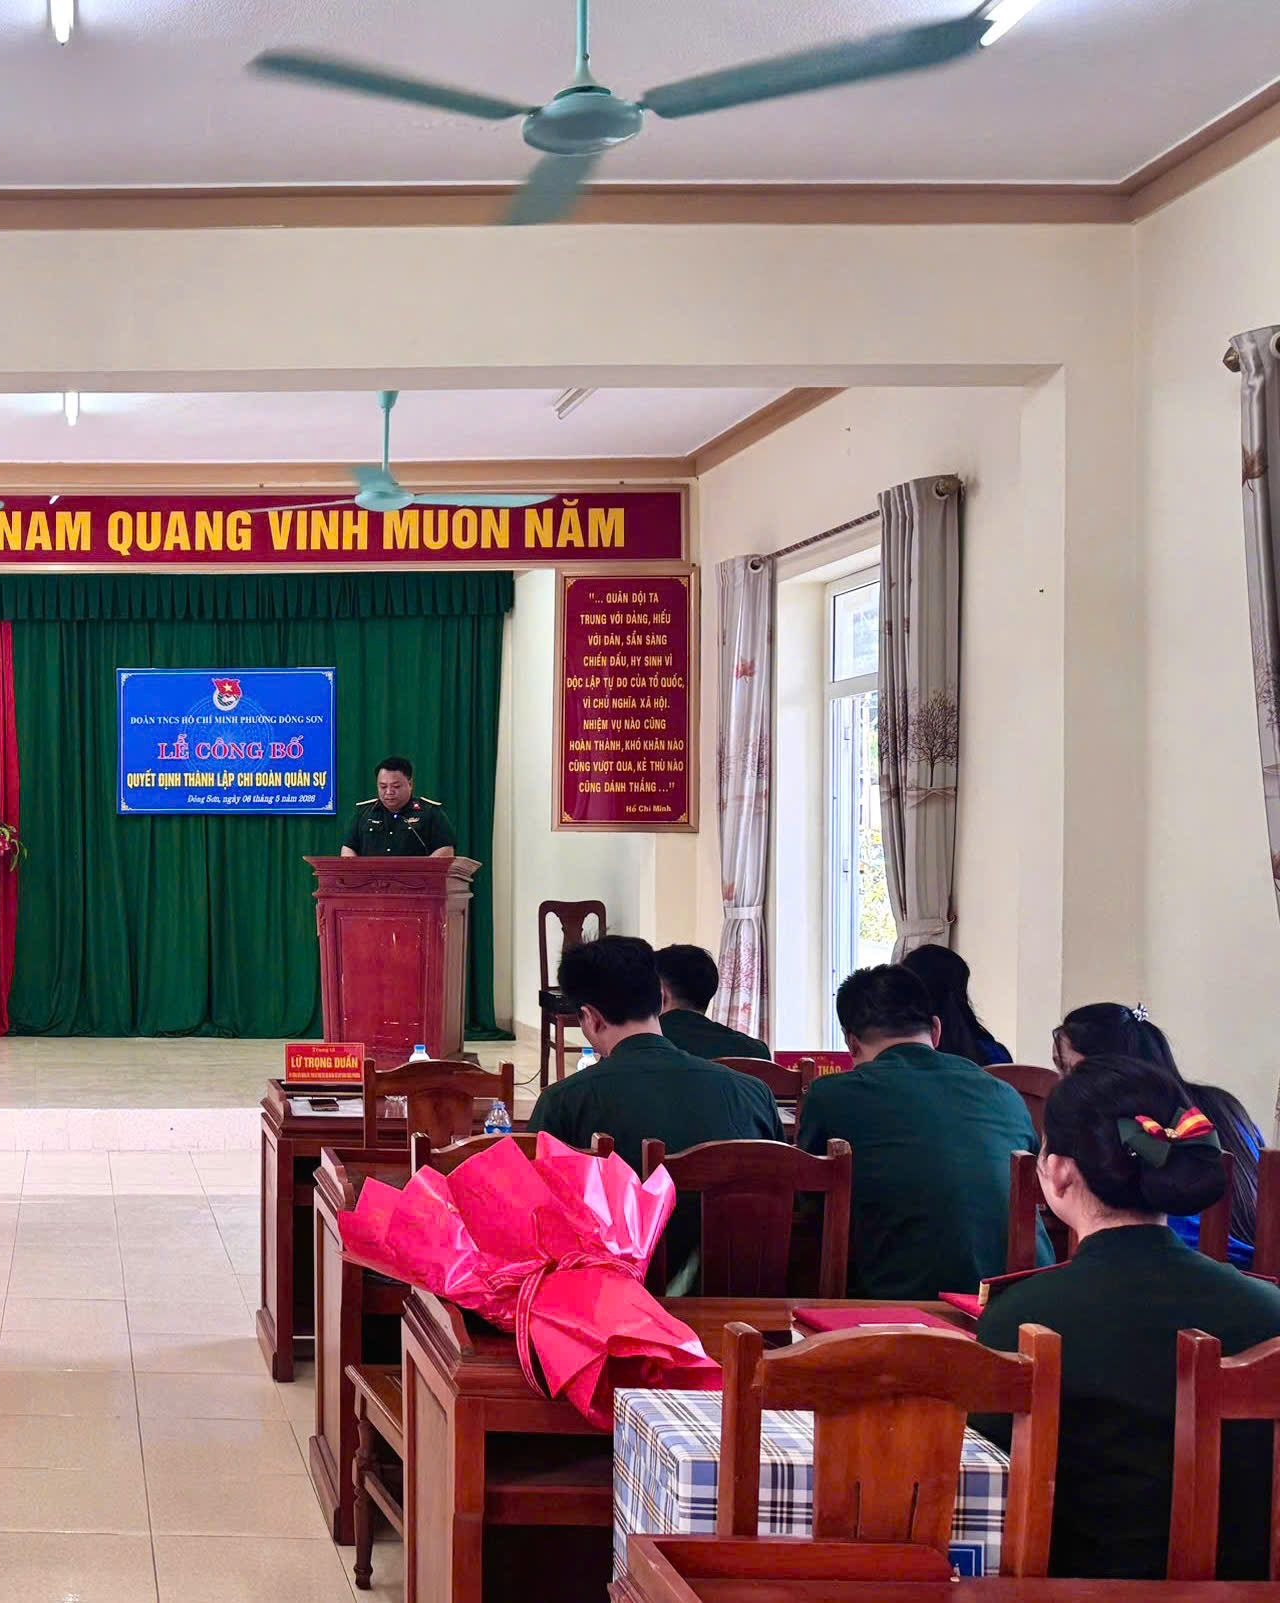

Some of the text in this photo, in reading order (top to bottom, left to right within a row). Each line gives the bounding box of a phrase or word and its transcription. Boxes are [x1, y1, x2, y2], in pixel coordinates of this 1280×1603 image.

[107, 510, 252, 557] QUANG
[267, 510, 368, 550] VINH
[524, 498, 625, 549] NĂM
[606, 591, 628, 603] QUÂN
[632, 591, 646, 606] ĐỘI
[649, 593, 658, 603] TA
[580, 614, 606, 624] TRUNG
[610, 611, 623, 624] VỚI
[653, 609, 671, 624] HIẾU
[588, 633, 601, 645] VỚI
[604, 633, 624, 646] DÂN,
[646, 632, 667, 645] SÀNG
[584, 651, 606, 666] CHIẾN
[631, 656, 641, 666] HY
[644, 656, 662, 666] SINH
[665, 653, 672, 666] VÌ
[567, 675, 583, 690] ĐỘC
[586, 675, 600, 690] LẬP
[604, 677, 614, 690] TỰ
[617, 678, 627, 687] DO
[631, 673, 646, 687] CỦA
[649, 672, 658, 687] TỔ
[583, 696, 590, 708] VÌ
[593, 695, 609, 708] CHỦ
[612, 696, 636, 708] NGHĨA
[640, 696, 651, 708] XÃ
[130, 715, 155, 724] ĐOÀN
[182, 715, 194, 724] HỒ
[196, 715, 212, 724] CHÍ
[214, 716, 238, 724] MINH
[240, 714, 277, 724] PHƯỜNG
[584, 717, 666, 732] NHIỆM VỤ NÀO CŨNG
[158, 734, 304, 760] LỄ CÔNG BỐ
[570, 739, 591, 751] HOÀN
[625, 737, 641, 751] KHÓ
[643, 738, 664, 751] KHĂN
[668, 737, 684, 751] NÀO
[569, 759, 590, 771] CŨNG
[593, 761, 613, 774] VƯỢT
[637, 757, 647, 771] KẺ
[650, 759, 665, 771] THÙ
[667, 759, 684, 771] NÀO
[127, 768, 327, 790] QUYẾT ĐỊNH THÀNH LẬP CHI ĐOÀN QUÂN SỰ
[579, 780, 600, 792] CŨNG
[604, 780, 626, 792] ĐÁNH
[629, 777, 656, 792] THẮNG
[223, 795, 241, 804] ngày
[253, 794, 274, 804] tháng
[304, 1056, 332, 1070] TRỌNG
